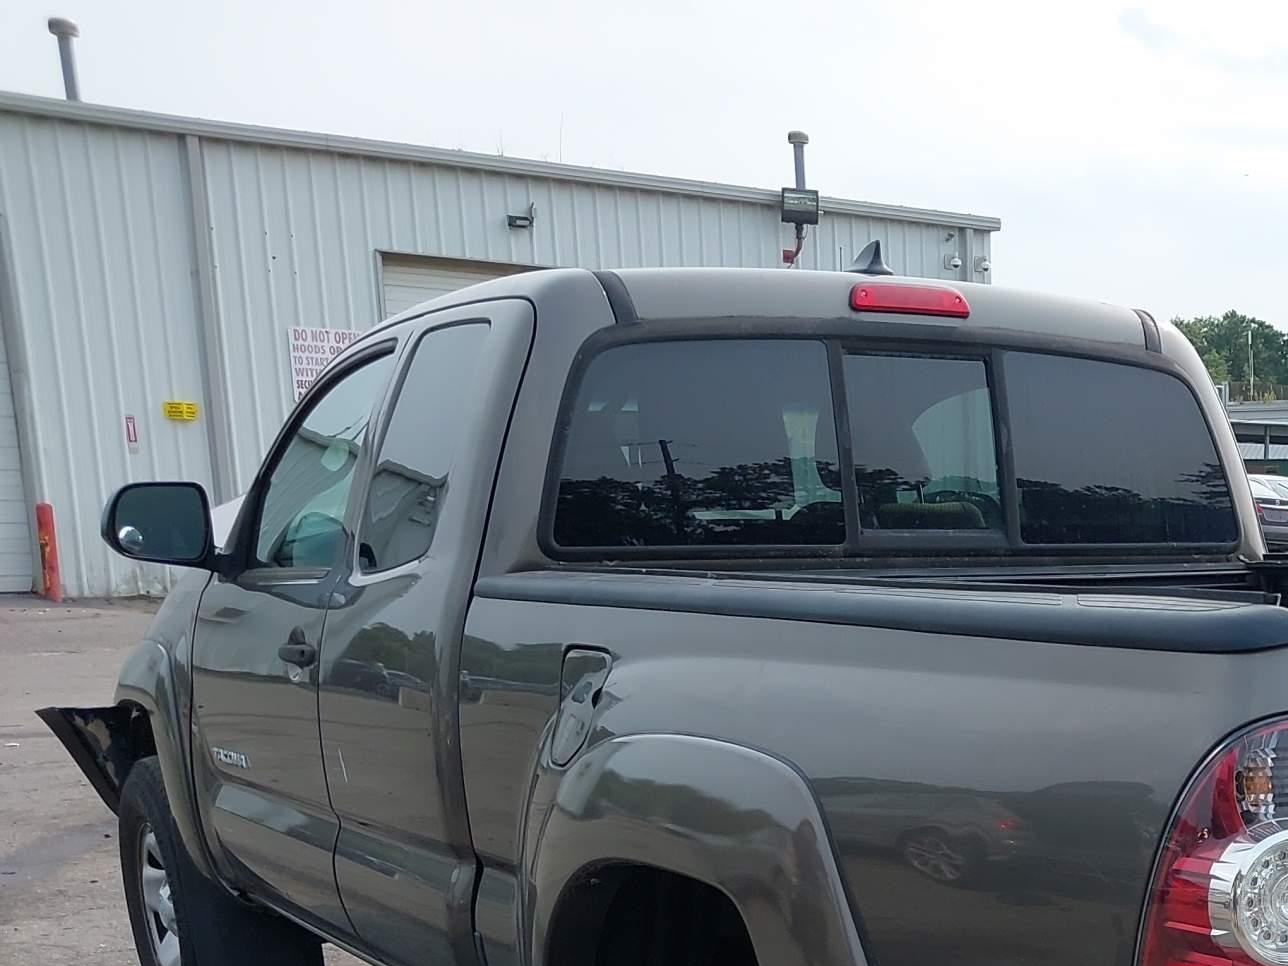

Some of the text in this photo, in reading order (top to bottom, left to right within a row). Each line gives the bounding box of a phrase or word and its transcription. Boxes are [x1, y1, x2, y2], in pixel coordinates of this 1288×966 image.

[293, 328, 308, 342] DO
[311, 330, 331, 343] NOT
[292, 343, 326, 354] HOODS
[292, 356, 303, 366] TO
